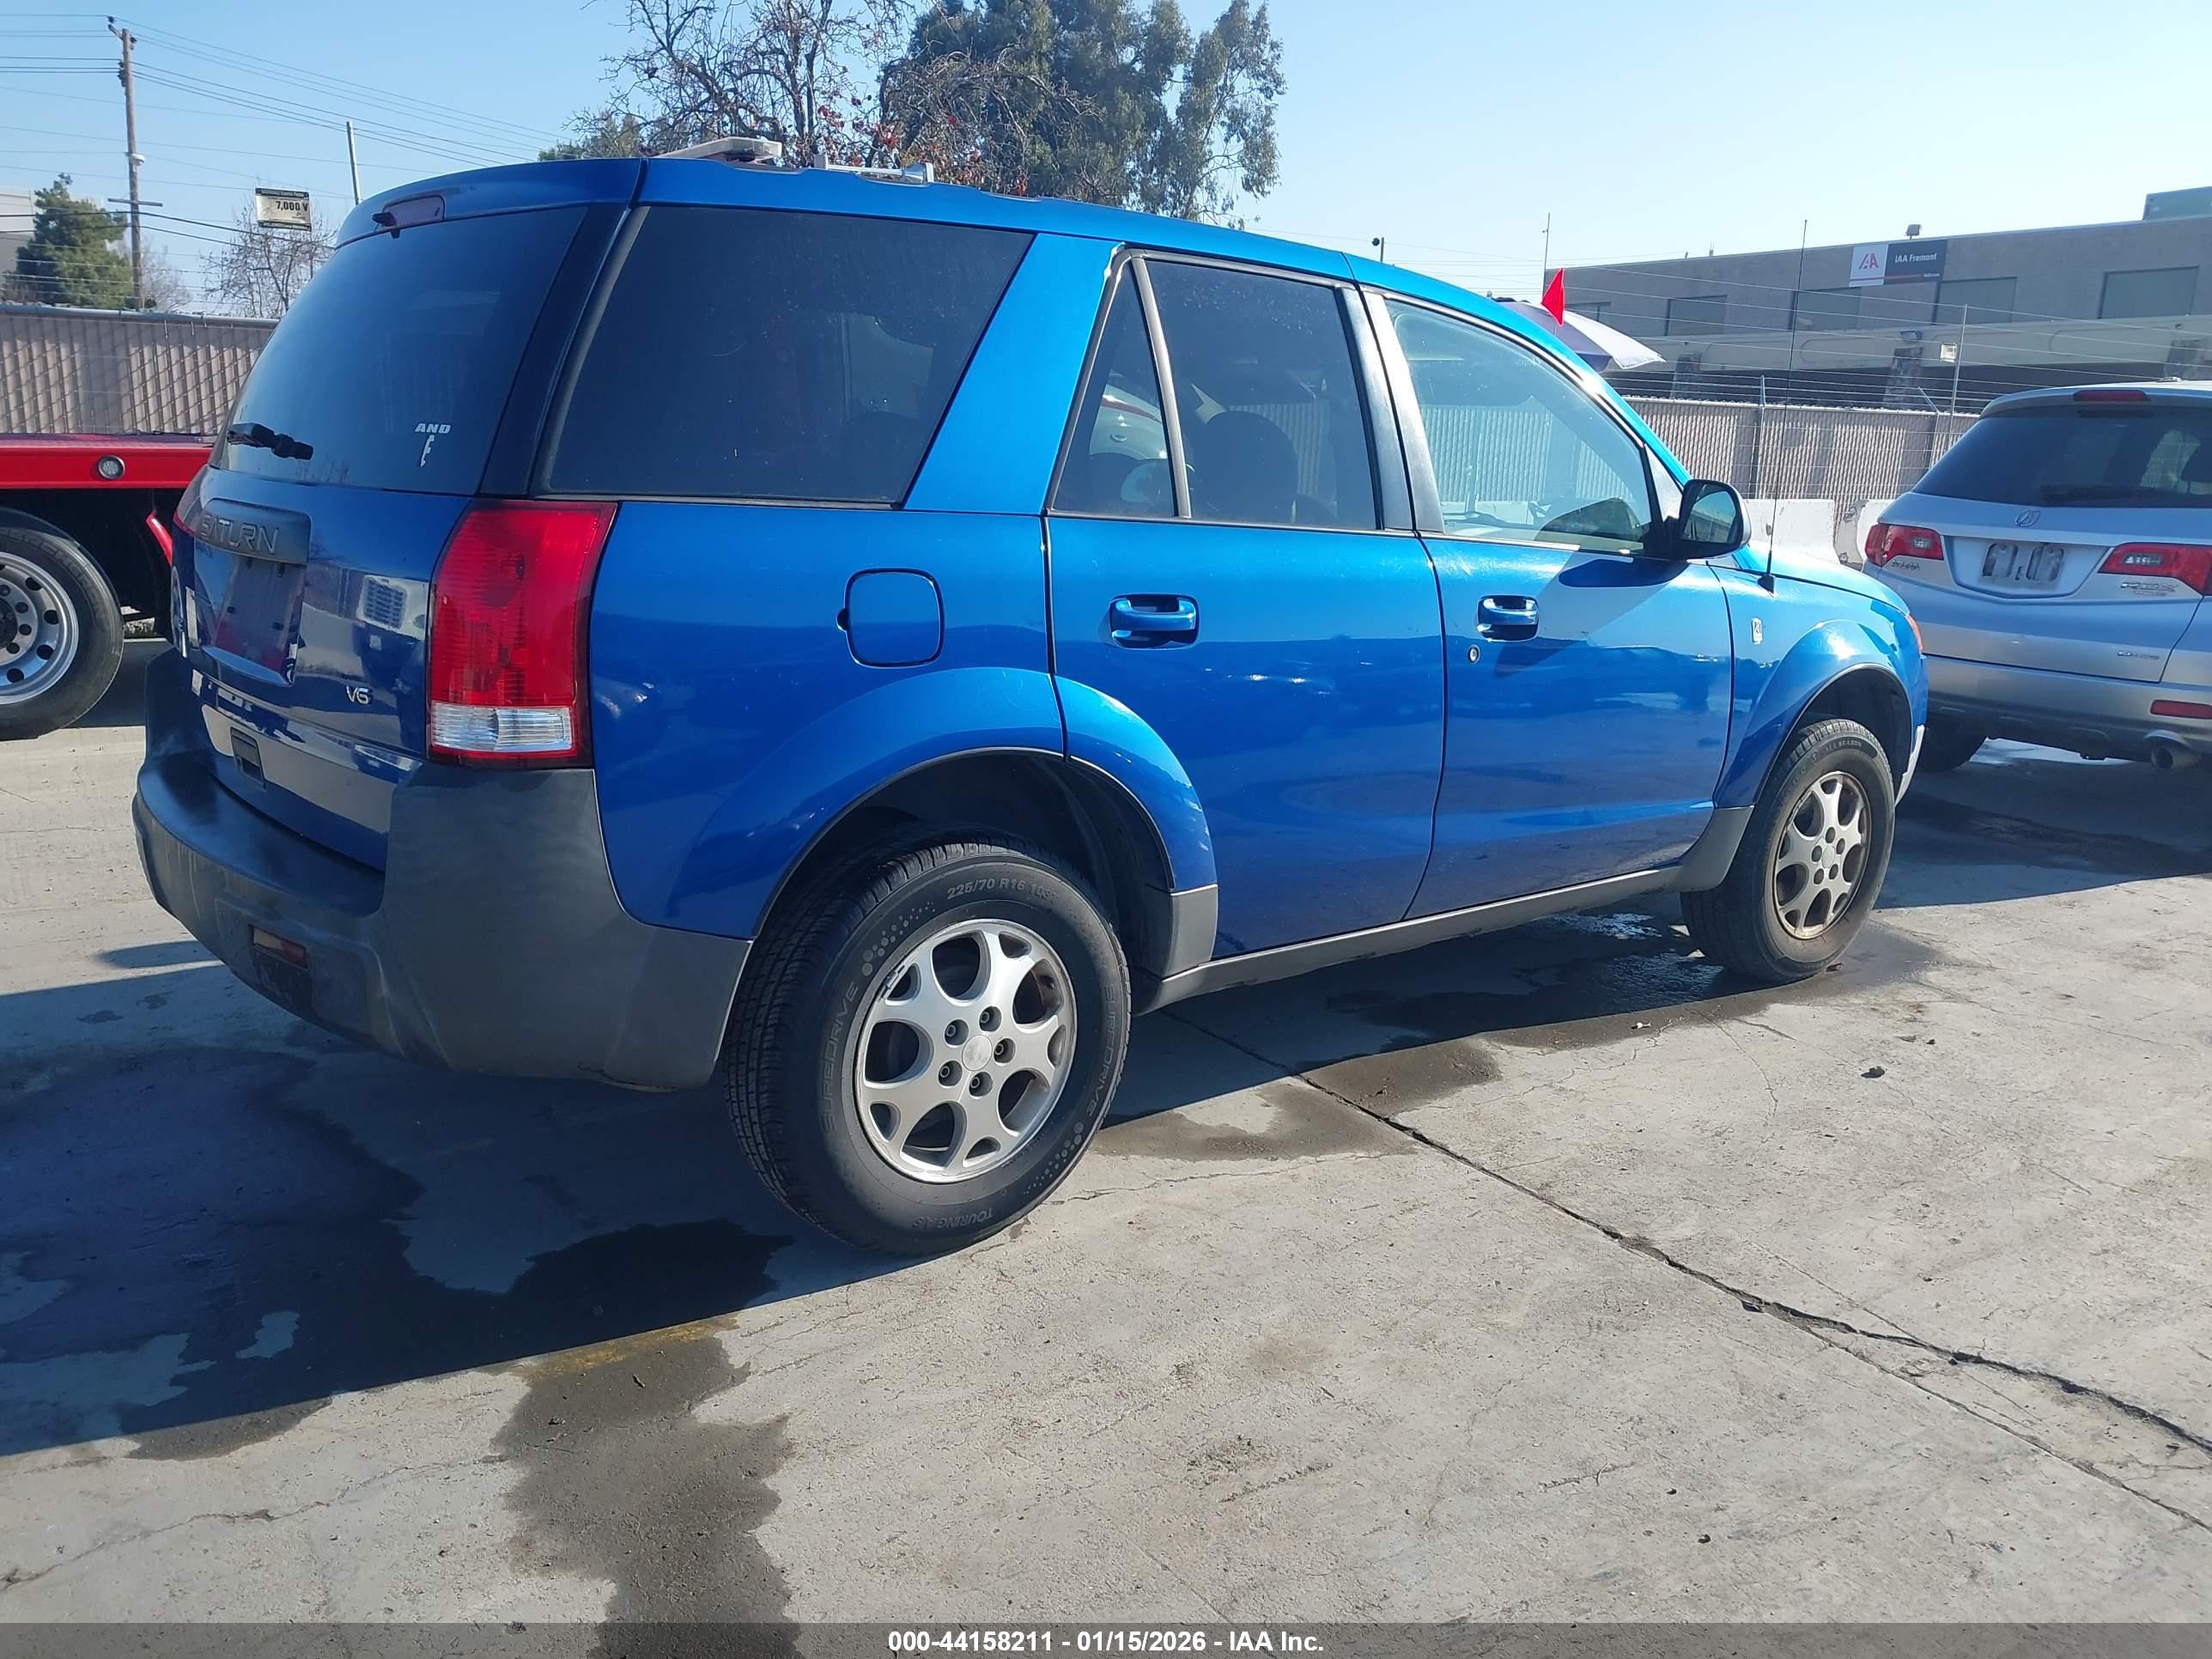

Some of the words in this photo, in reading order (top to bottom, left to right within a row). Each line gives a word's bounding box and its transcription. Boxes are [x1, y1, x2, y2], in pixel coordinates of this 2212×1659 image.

[276, 201, 301, 211] 7,000
[1909, 253, 1937, 262] Fremont
[415, 423, 451, 434] AND
[199, 514, 280, 556] SATURN
[346, 685, 369, 704] V6
[947, 878, 995, 900] 225/70
[999, 878, 1027, 891] R16
[821, 981, 859, 1134] SUREDRIVE
[1086, 984, 1115, 1116] SUREDRIVE
[934, 1207, 994, 1230] TOURING
